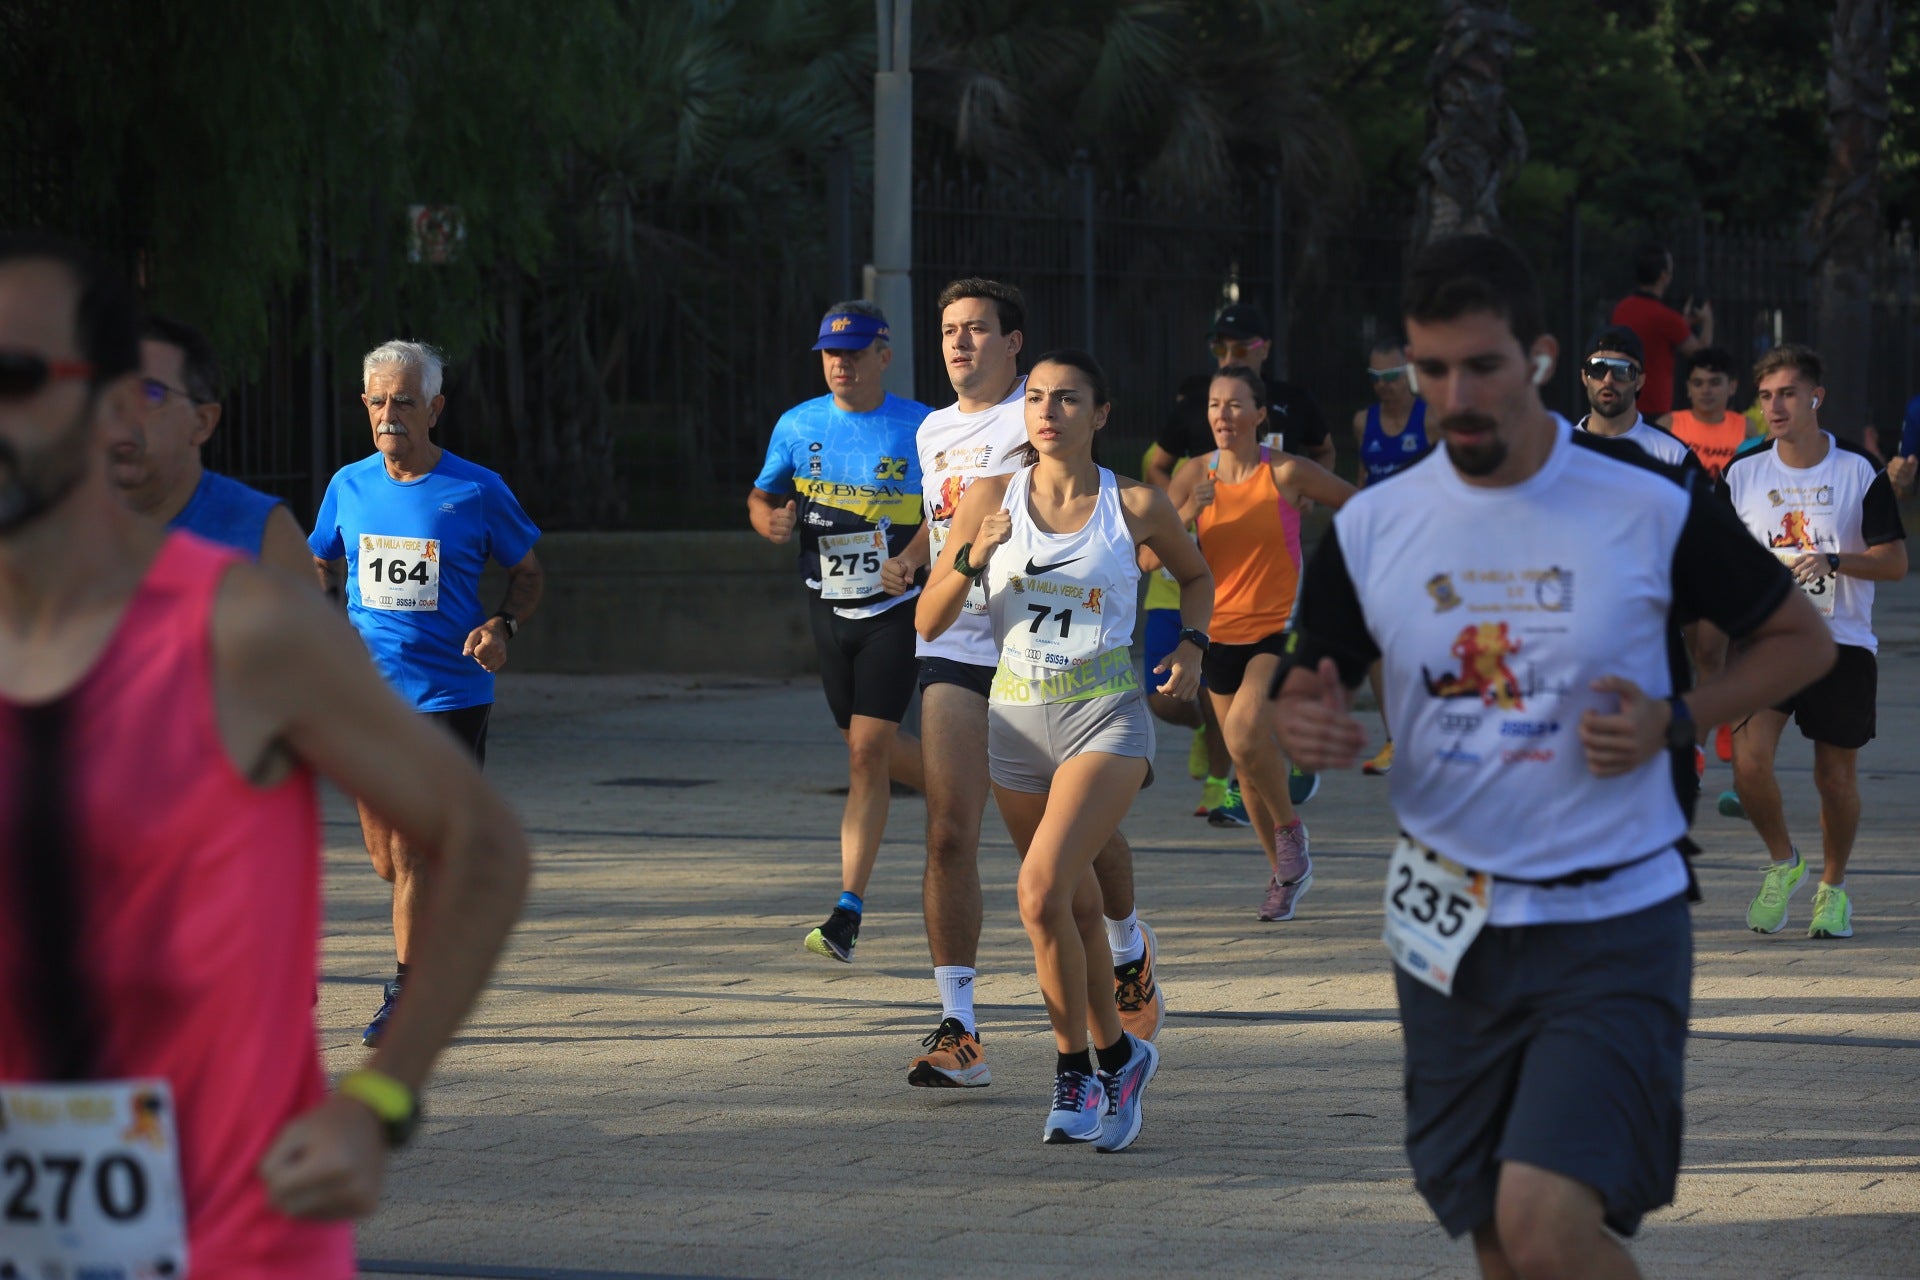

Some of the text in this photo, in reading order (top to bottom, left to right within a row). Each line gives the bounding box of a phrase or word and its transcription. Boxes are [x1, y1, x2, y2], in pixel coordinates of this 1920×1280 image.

[808, 482, 904, 497] RUBYSAN
[383, 539, 400, 550] MILLA
[402, 541, 421, 551] VERDE
[369, 558, 429, 585] 164
[828, 551, 880, 576] 275
[1026, 580, 1084, 599] VII MILLA VERDE
[1027, 603, 1073, 638] 71
[1045, 653, 1064, 665] asisa
[1041, 660, 1096, 700] NIKE
[1392, 864, 1472, 937] 235
[3, 1153, 148, 1226] 270
